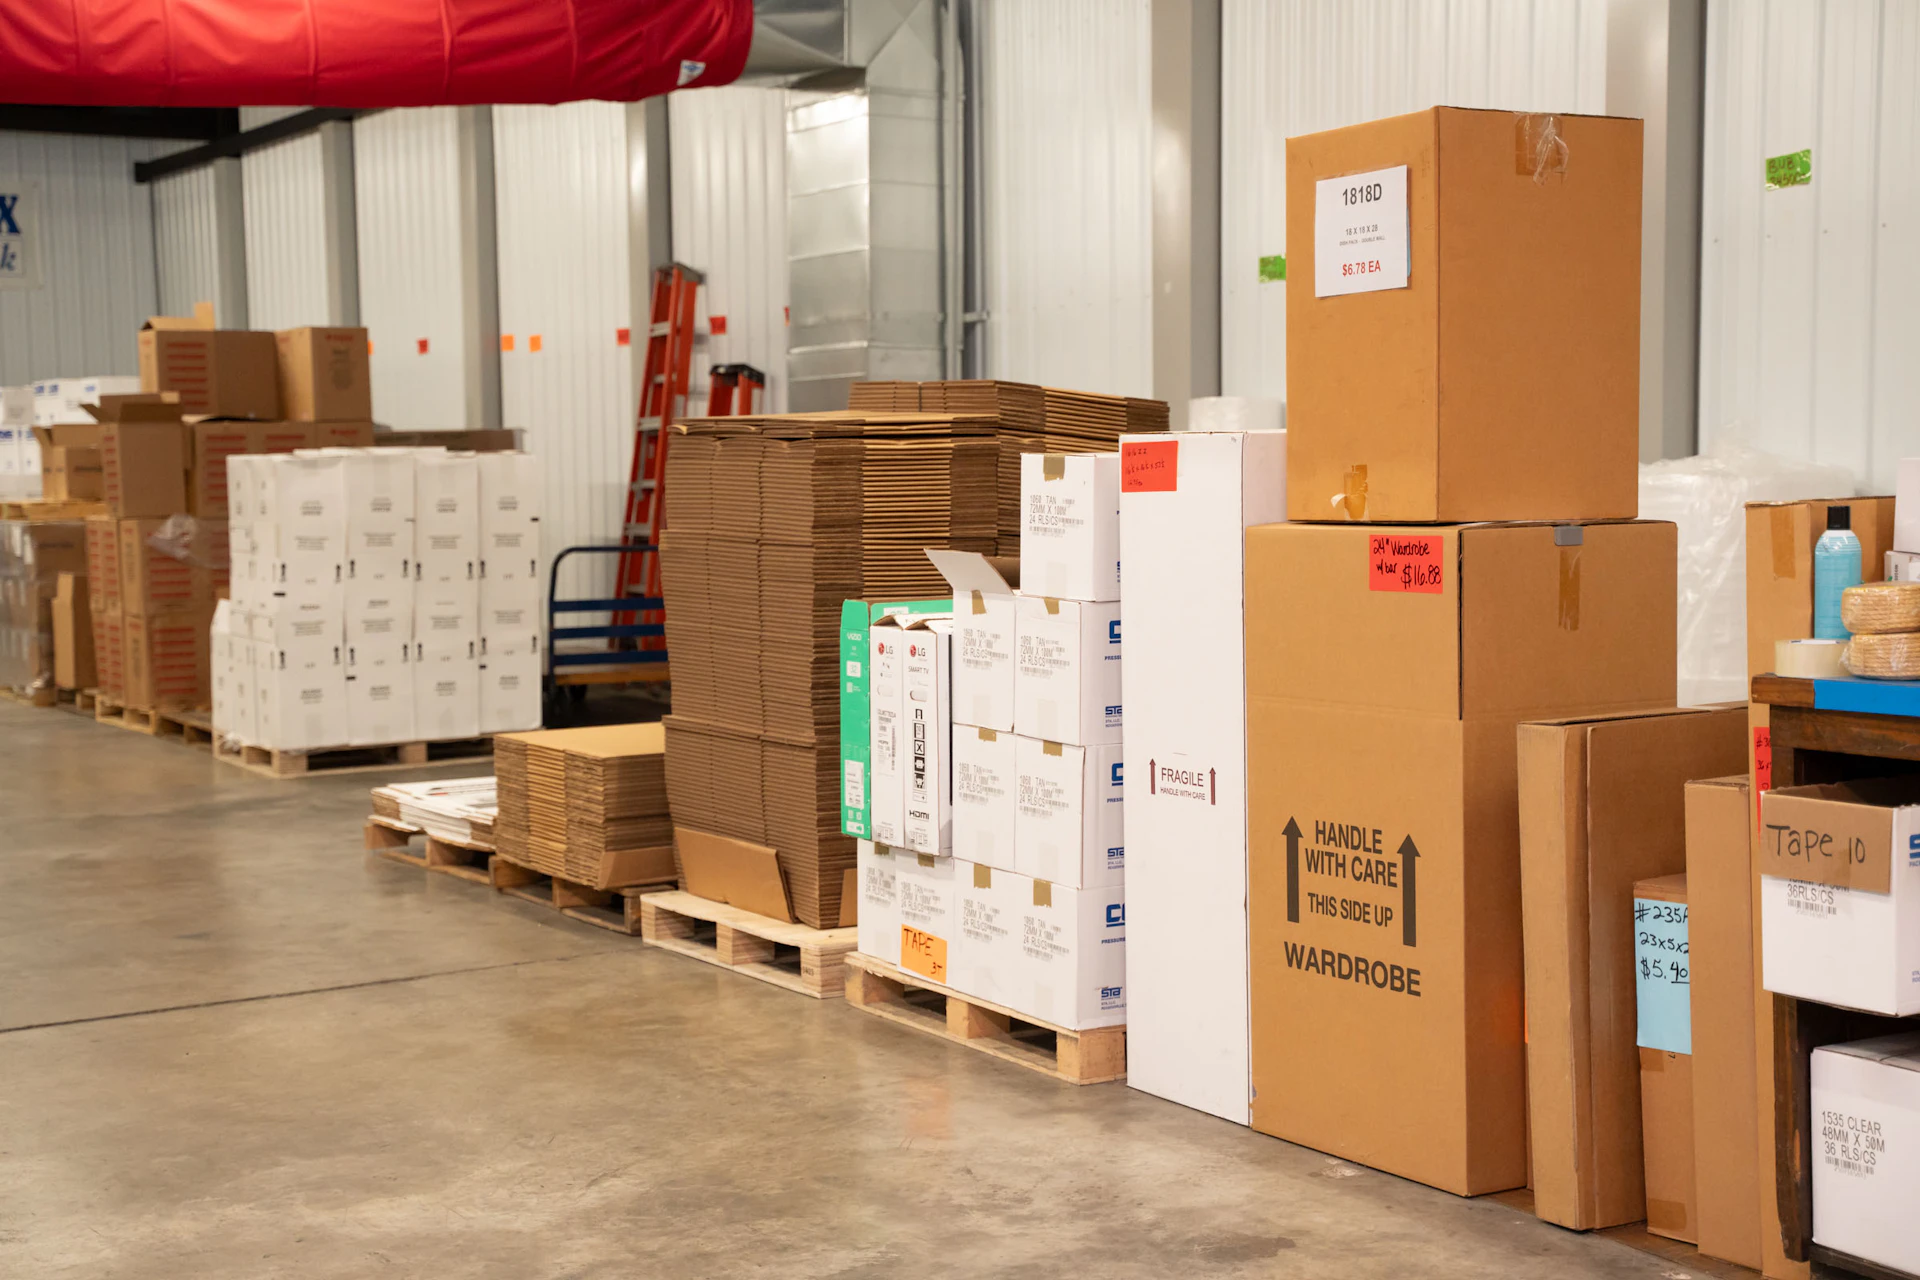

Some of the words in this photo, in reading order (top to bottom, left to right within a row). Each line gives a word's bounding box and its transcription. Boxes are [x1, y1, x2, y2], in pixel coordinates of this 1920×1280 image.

[1342, 183, 1382, 206] 1818D
[1360, 226, 1366, 234] 18
[1342, 262, 1366, 277] $6.78
[1368, 260, 1381, 273] EA
[1373, 537, 1389, 555] 24"
[1391, 540, 1430, 556] Wardrobe
[1385, 561, 1397, 574] bar
[1401, 563, 1442, 590] $16.88
[918, 648, 926, 656] LG
[908, 666, 922, 674] SMART
[1161, 767, 1204, 787] FRAGILE
[1160, 787, 1178, 796] HANDLE
[1180, 790, 1191, 798] WITH
[1192, 792, 1206, 800] CARE
[909, 809, 929, 820] HDMI
[1316, 820, 1382, 855] HANDLE
[1766, 824, 1833, 863] Tape
[1849, 837, 1866, 864] 10
[1305, 848, 1346, 878] WITH
[1351, 856, 1398, 888] CARE
[1308, 892, 1337, 917] THIS
[1340, 898, 1371, 924] SIDE
[1375, 904, 1393, 927] UP
[904, 928, 934, 957] TAPE
[1284, 941, 1421, 997] WARDROBE
[1641, 956, 1688, 982] $5.40
[1822, 1110, 1844, 1127] 1535
[1847, 1116, 1882, 1136] CLEAR
[1822, 1126, 1848, 1144] 48MM
[1853, 1132, 1860, 1147] X
[1865, 1136, 1885, 1153] 50M
[1824, 1141, 1836, 1155] 36
[1841, 1144, 1876, 1165] RLS/CS
